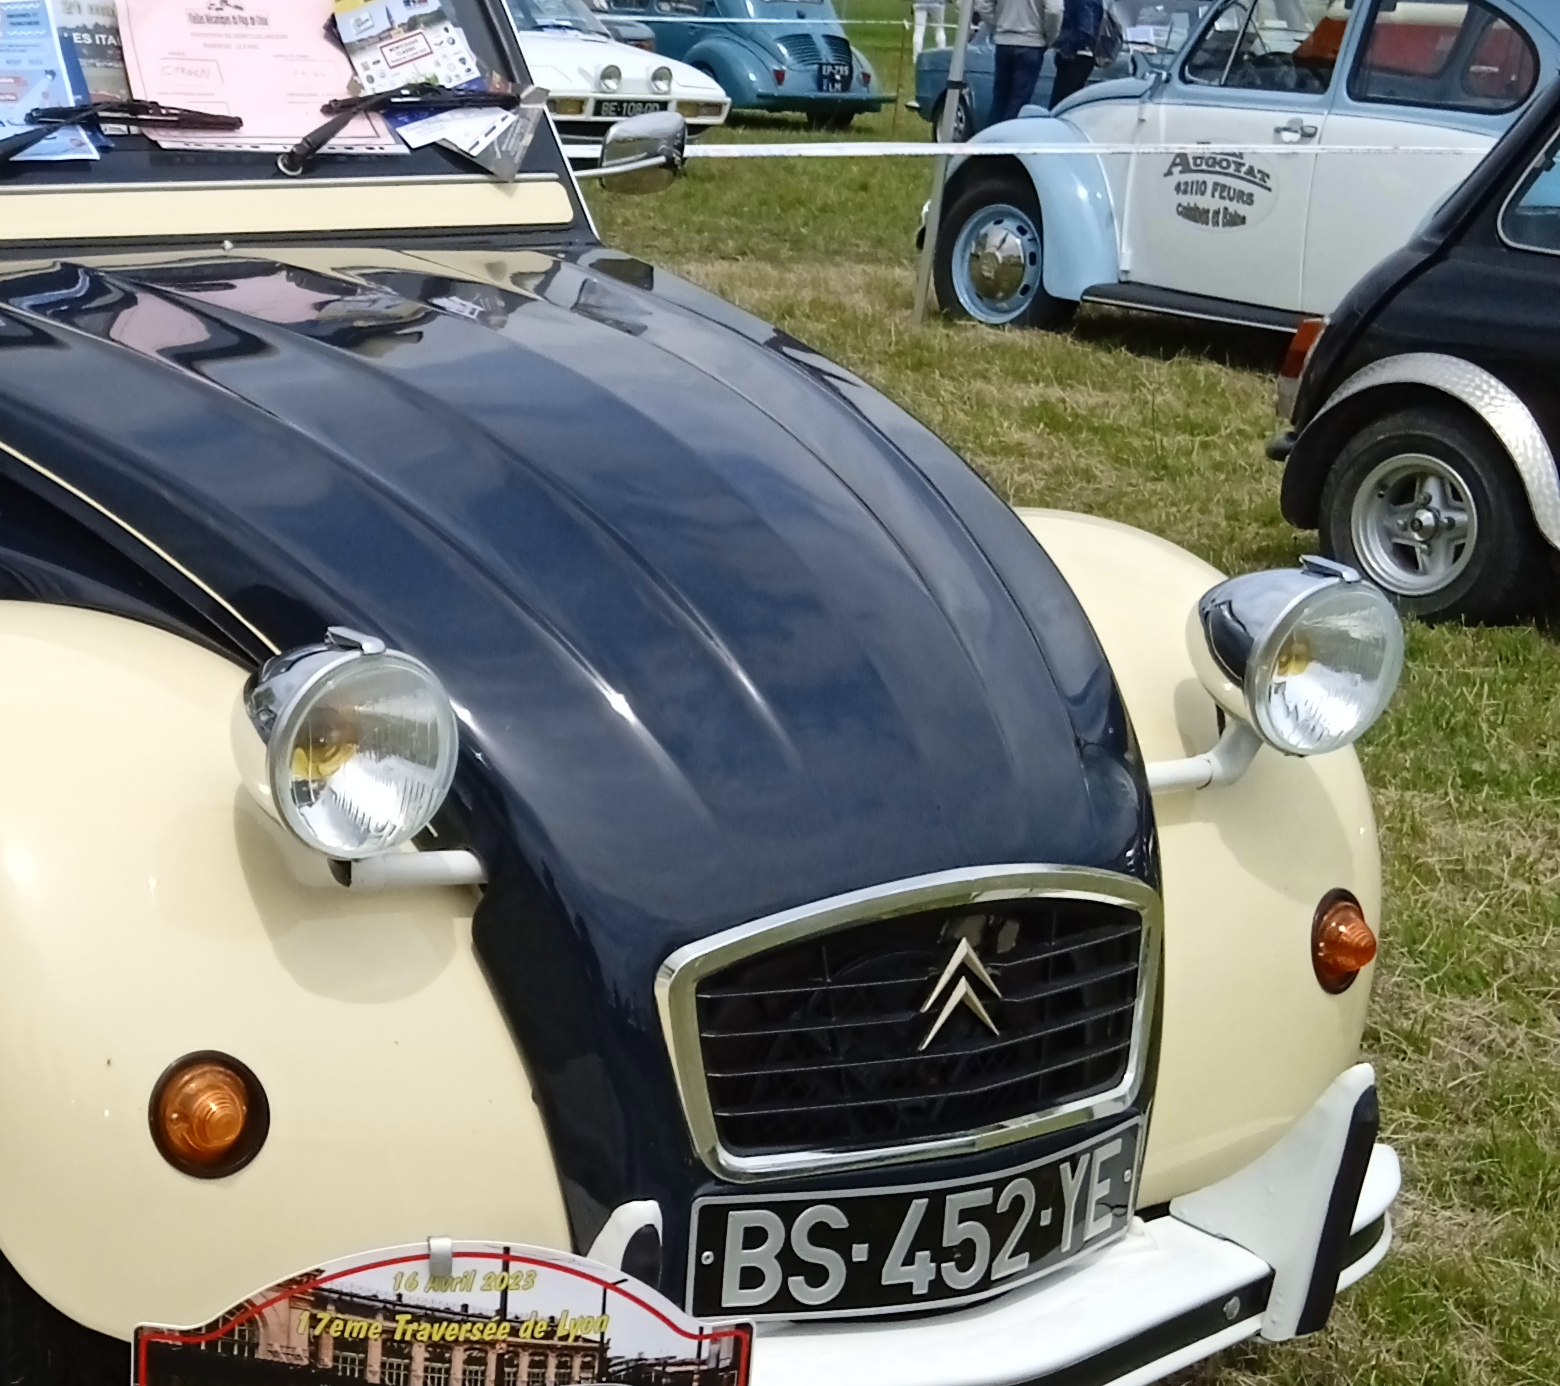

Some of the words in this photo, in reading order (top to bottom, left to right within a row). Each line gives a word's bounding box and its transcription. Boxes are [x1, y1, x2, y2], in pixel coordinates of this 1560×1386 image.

[1163, 152, 1271, 184] AUGOYAT
[1211, 181, 1255, 206] FEURS
[393, 1271, 419, 1292] 16
[480, 1270, 537, 1292] 2023
[393, 1313, 510, 1342] Traversée
[518, 1310, 547, 1339] de
[556, 1310, 611, 1344] Lyon
